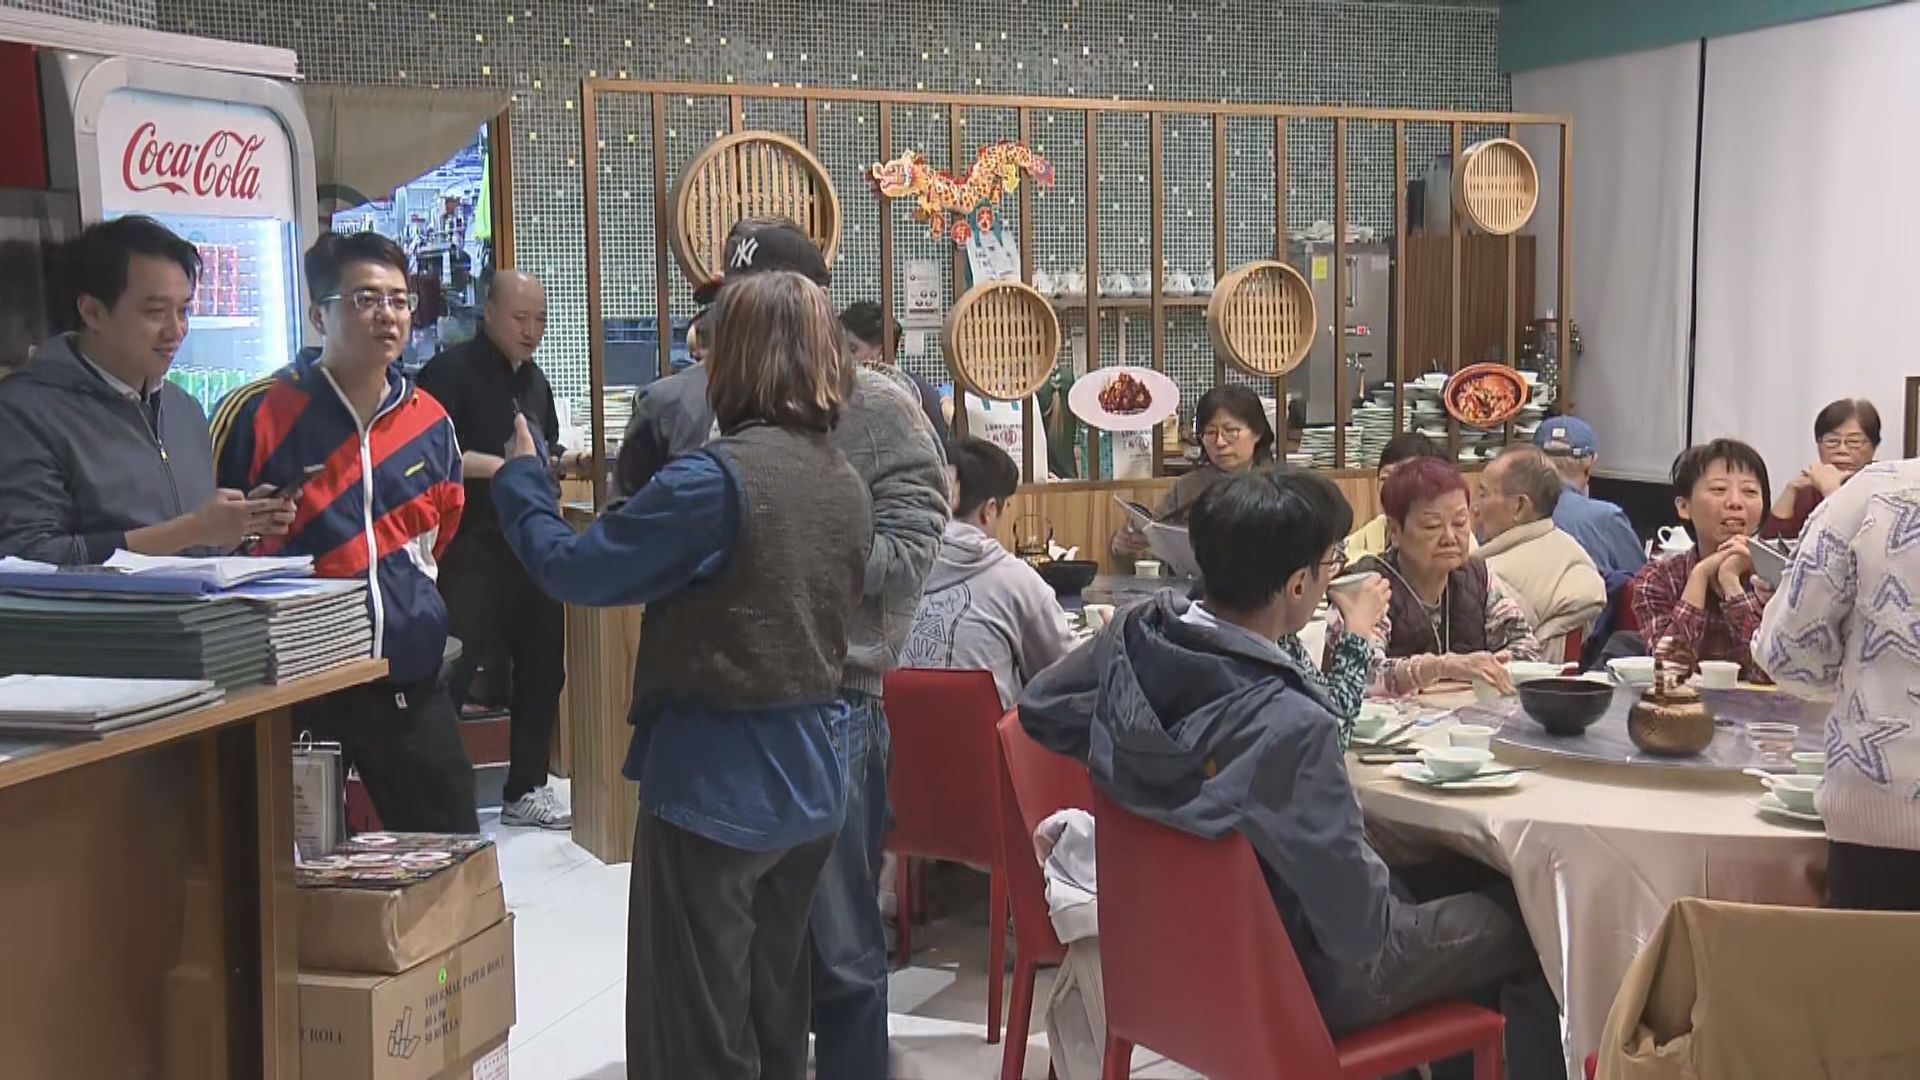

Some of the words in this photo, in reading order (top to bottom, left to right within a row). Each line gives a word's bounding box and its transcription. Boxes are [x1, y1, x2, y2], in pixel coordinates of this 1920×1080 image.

[122, 121, 266, 200] Coca-Cola
[730, 237, 759, 268] NY
[425, 980, 460, 1009] THERMAL
[463, 966, 486, 989] PAPER
[310, 1028, 343, 1044] ROLL
